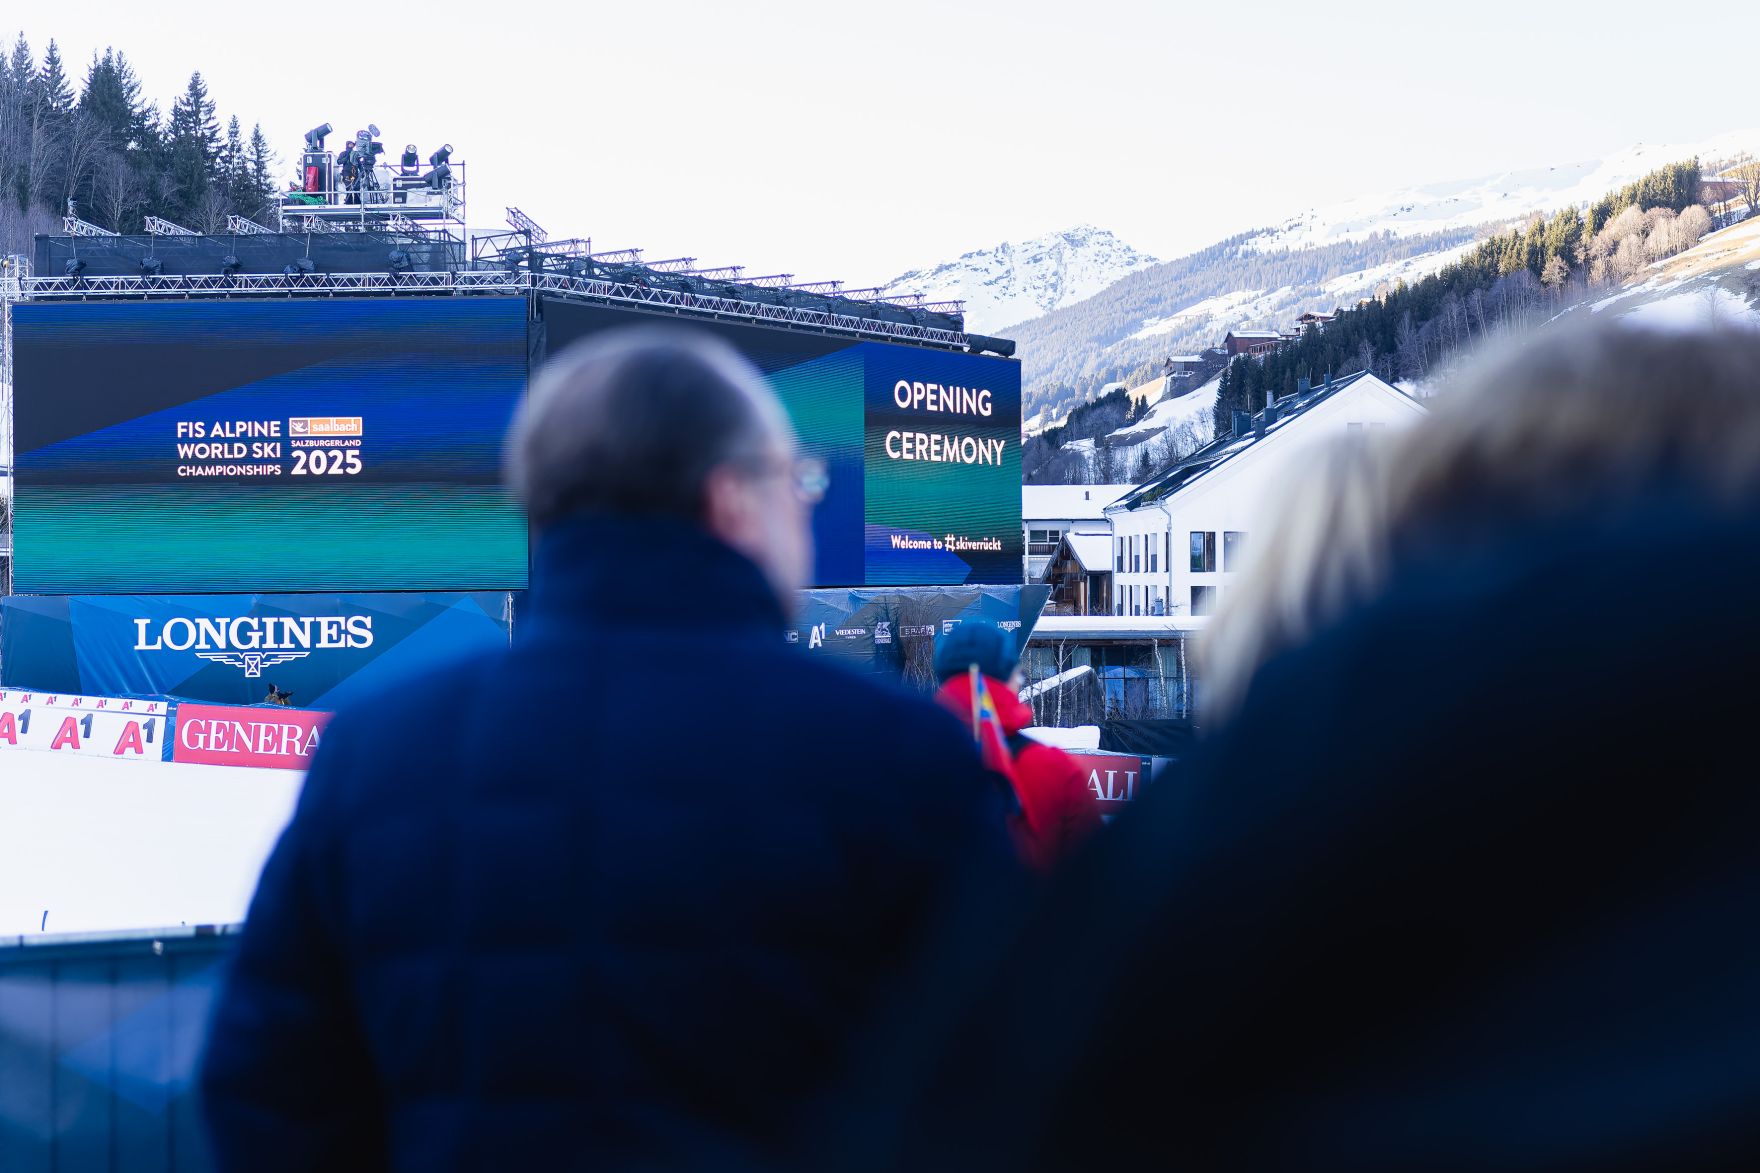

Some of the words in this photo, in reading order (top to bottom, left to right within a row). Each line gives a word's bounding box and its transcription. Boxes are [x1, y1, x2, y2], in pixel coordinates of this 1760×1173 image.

[894, 380, 992, 416] OPENING
[177, 421, 206, 438] FIS
[210, 421, 281, 437] ALPINE
[312, 419, 358, 432] saalbach
[177, 443, 248, 459] WORLD
[252, 442, 281, 458] SKI
[885, 430, 1006, 466] CEREMONY
[177, 464, 282, 476] CHAMPIONSHIPS
[290, 450, 363, 475] 2025
[891, 534, 932, 550] Welcome
[933, 538, 943, 549] to
[133, 615, 374, 651] LONGINES
[50, 713, 94, 750] A1
[113, 718, 156, 755] A1
